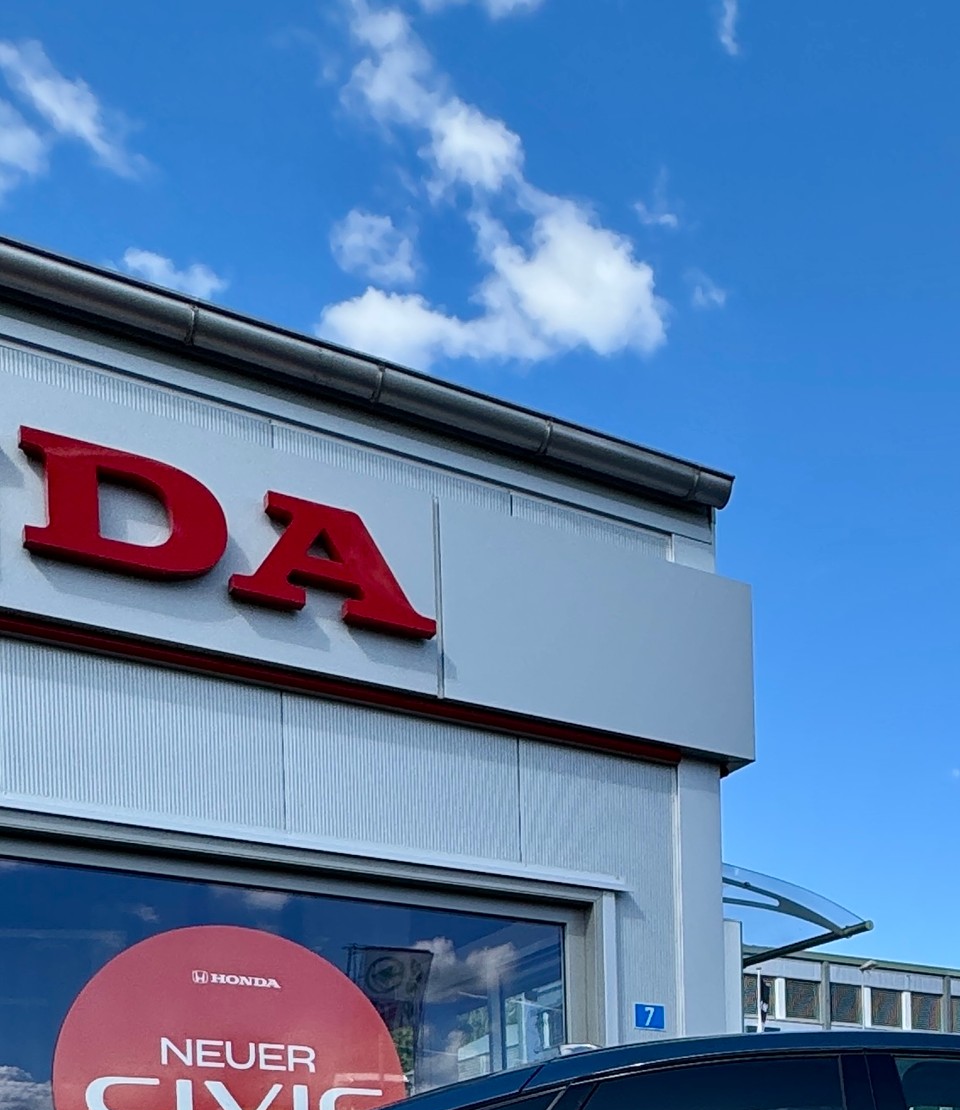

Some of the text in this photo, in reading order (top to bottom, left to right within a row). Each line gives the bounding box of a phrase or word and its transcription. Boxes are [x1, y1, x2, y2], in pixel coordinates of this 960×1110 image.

[210, 973, 281, 989] HONDA
[644, 1006, 655, 1026] 7
[160, 1037, 316, 1073] NEUER
